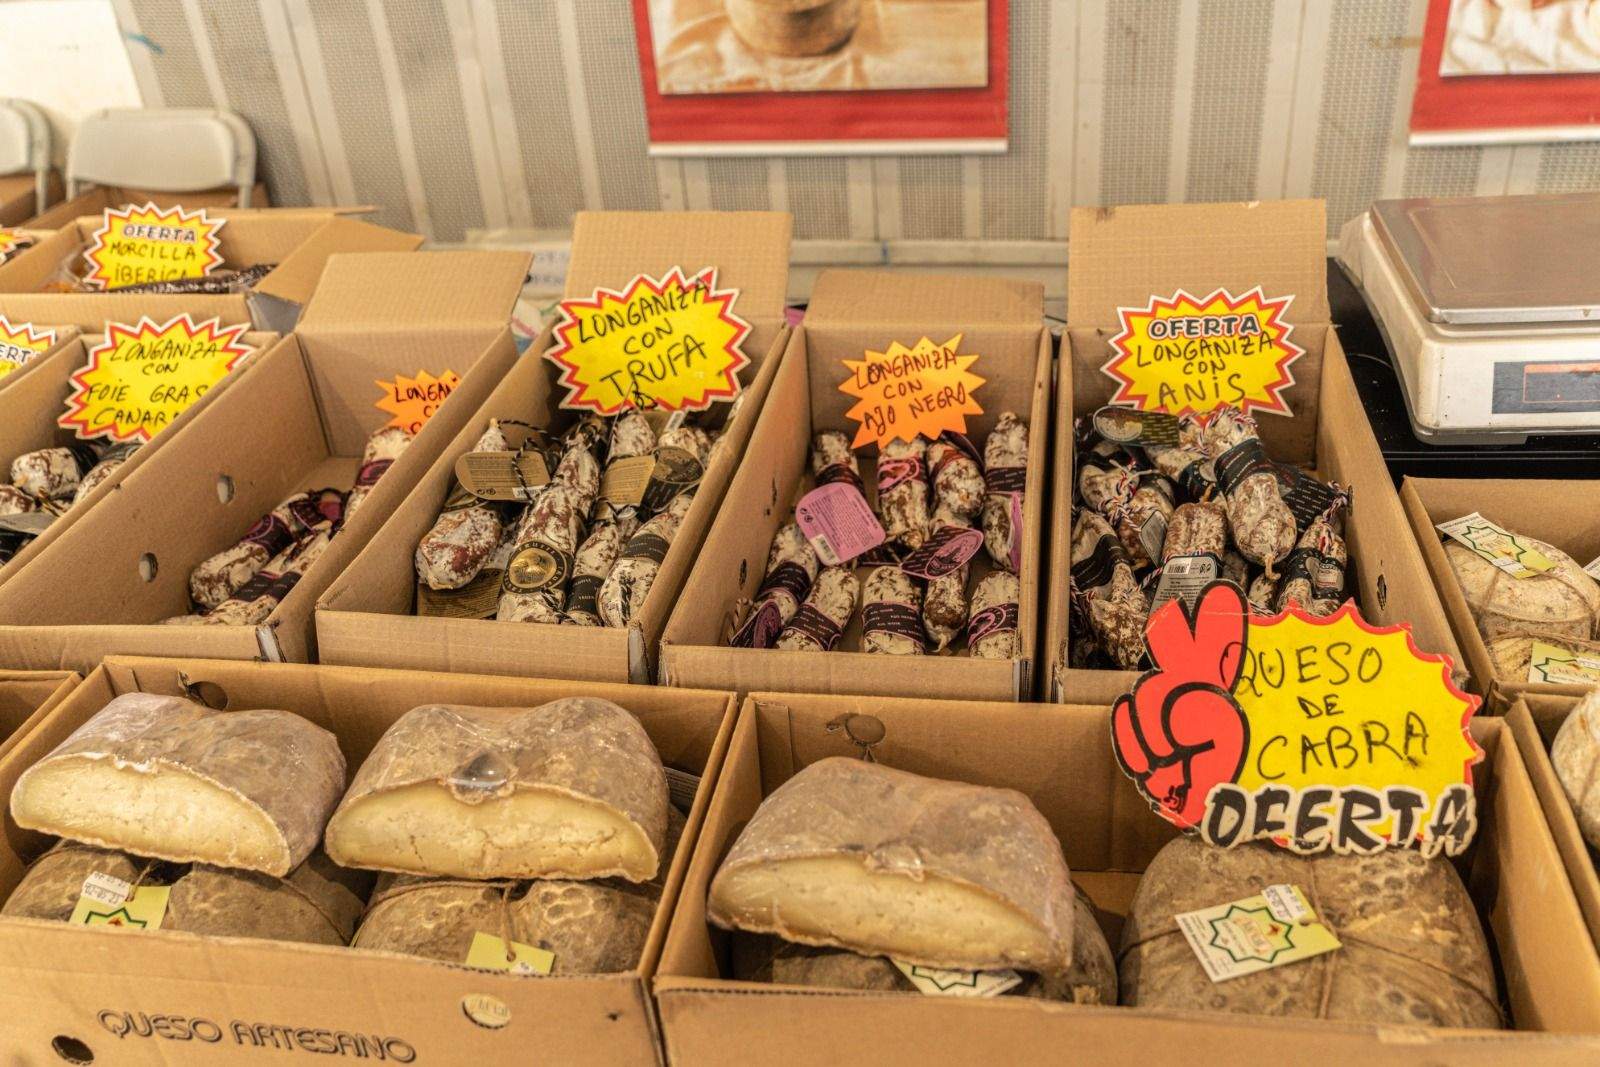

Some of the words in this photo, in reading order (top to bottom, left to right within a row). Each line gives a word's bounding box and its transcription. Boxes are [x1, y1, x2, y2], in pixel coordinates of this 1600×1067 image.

[109, 242, 196, 260] MORCILLA
[123, 224, 197, 242] OFERTA
[577, 276, 714, 344] LONGANIZA
[1149, 314, 1261, 340] OFERTA
[109, 339, 218, 362] LONGANIZA
[624, 318, 674, 355] CON
[1136, 331, 1275, 368] LONGANIZA
[142, 363, 179, 376] CON
[599, 334, 708, 397] TRUFA
[856, 347, 958, 390] LONGANIZA
[1182, 360, 1226, 375] CON
[85, 382, 130, 402] FOIE
[883, 379, 922, 399] CON
[864, 405, 896, 437] AJO
[908, 381, 966, 419] NEGRO
[1219, 641, 1383, 697] QUESO
[1297, 694, 1344, 719] DE
[1256, 711, 1430, 780] CABRA
[1205, 785, 1474, 855] OFERTA
[97, 1008, 224, 1044] QUESO
[230, 1020, 418, 1064] ARTESANO
